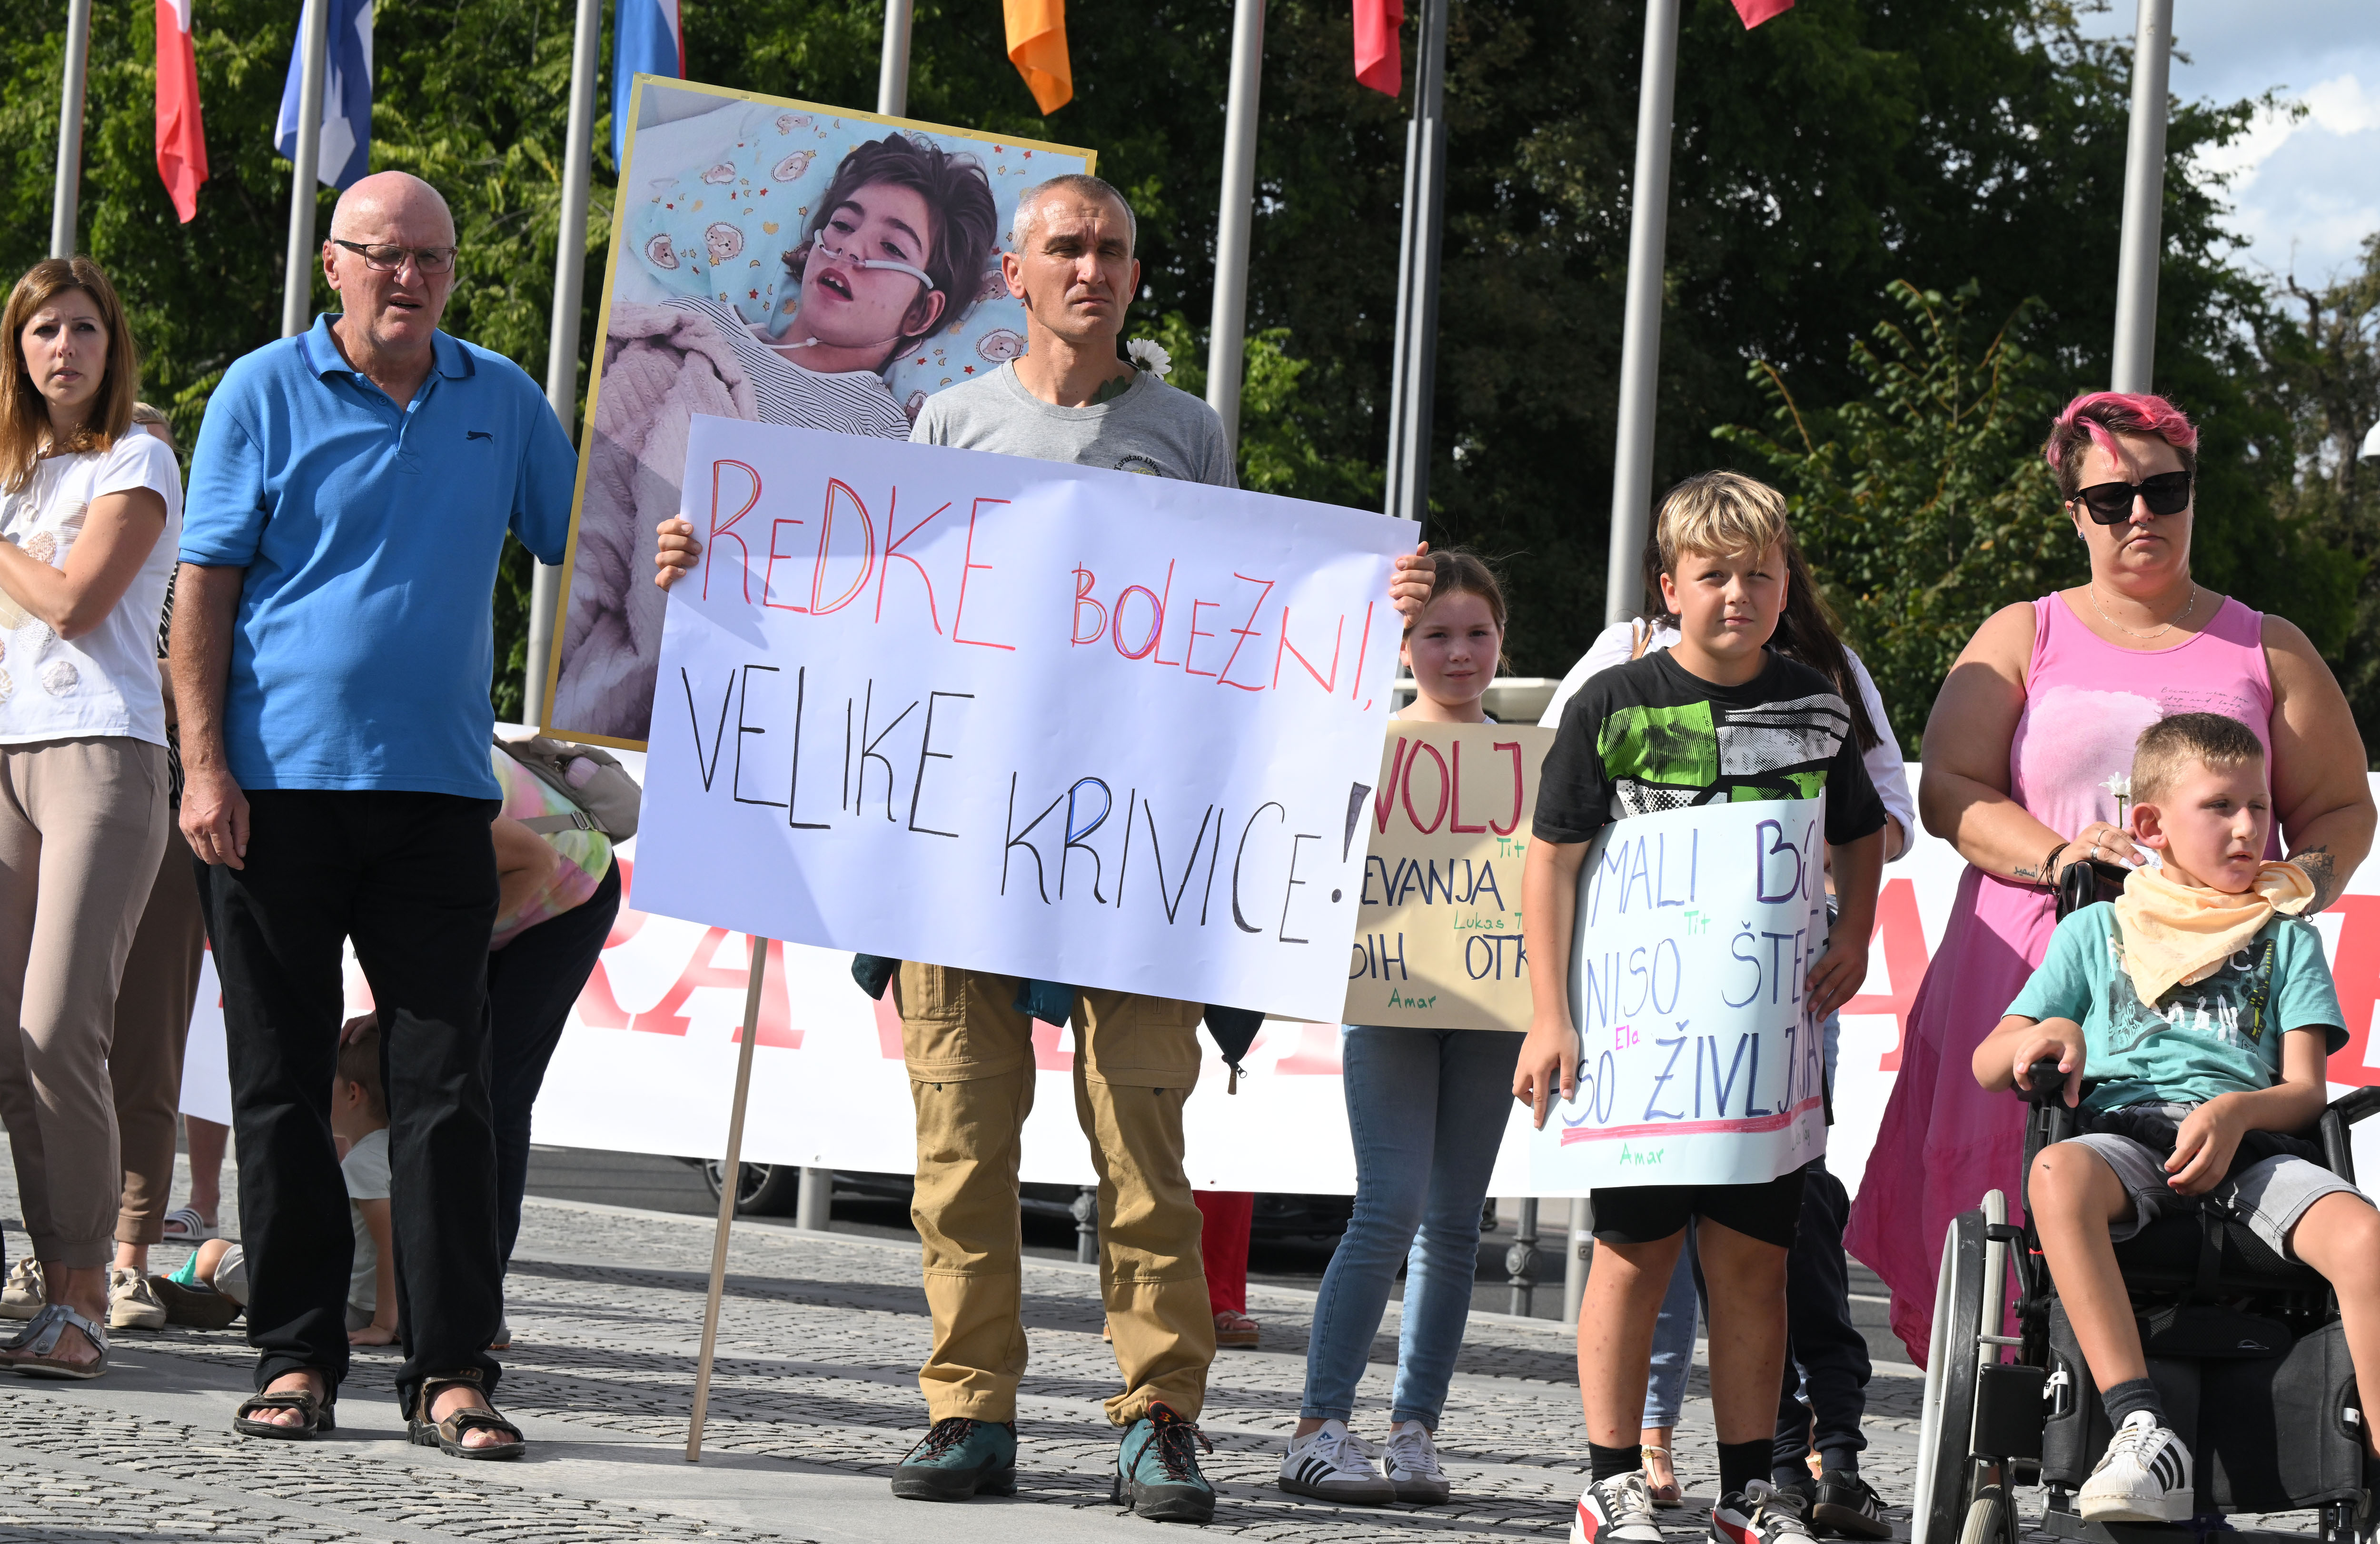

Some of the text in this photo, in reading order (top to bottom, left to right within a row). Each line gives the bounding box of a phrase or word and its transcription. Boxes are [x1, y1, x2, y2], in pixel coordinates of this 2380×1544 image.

[1114, 455, 1142, 471] Tarutao
[703, 459, 1373, 711] REDKE BOLEZNI,
[681, 665, 1372, 944] VELIKE KRIVICE!
[1374, 737, 1523, 836] VOLJ
[1497, 837, 1525, 858] Tit
[1361, 856, 1505, 911] EVANJA
[1591, 818, 1817, 927] MALI BO
[1454, 910, 1504, 929] Lukas
[1684, 910, 1711, 935] Tit
[1585, 938, 1681, 1034] NISO
[1721, 919, 1809, 1008] ŠTE
[1388, 987, 1436, 1008] Amar
[1615, 1025, 1640, 1050] Ela
[1562, 1050, 1614, 1127] SO
[1619, 1143, 1665, 1166] Amar
